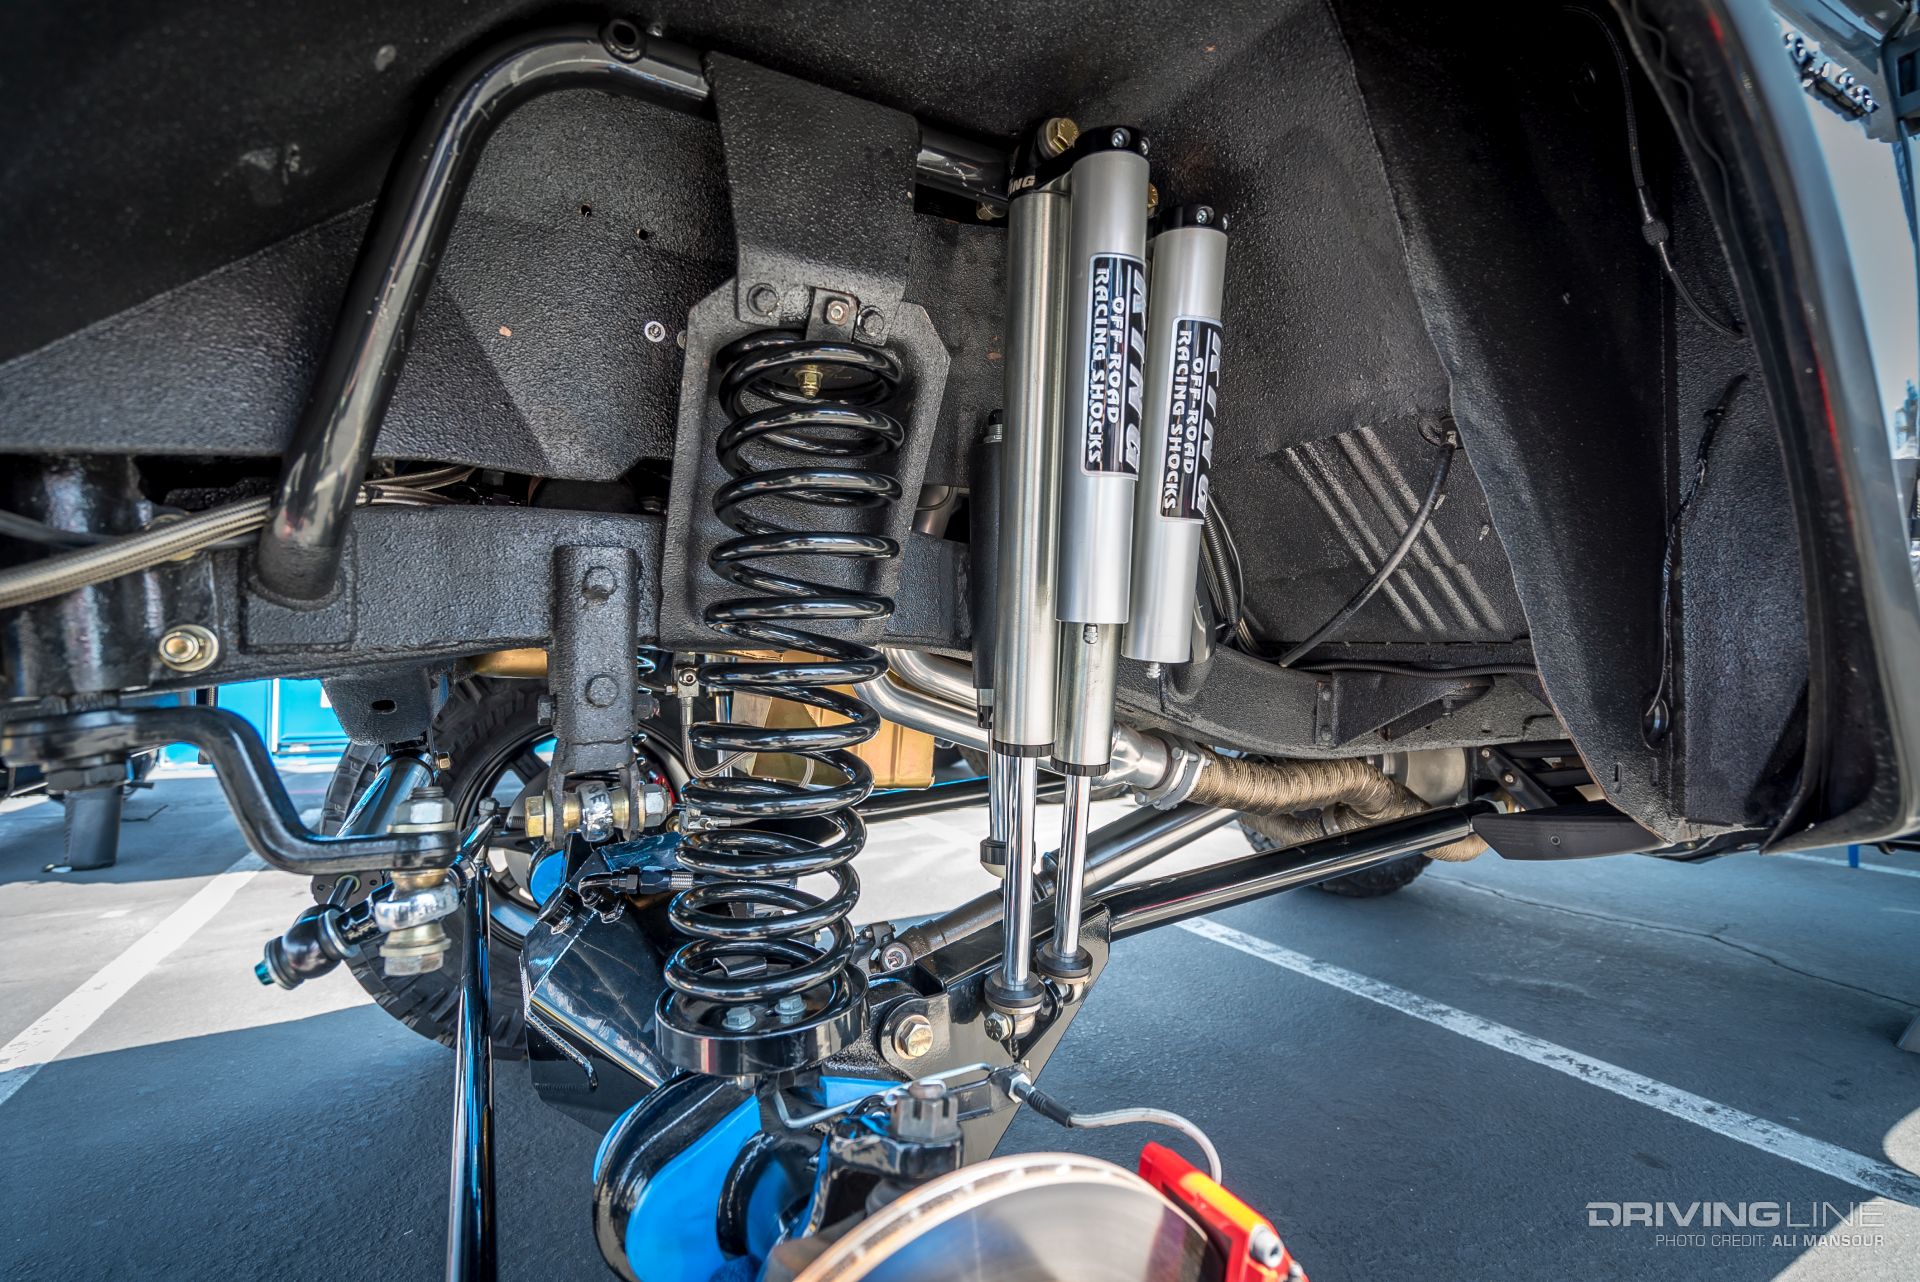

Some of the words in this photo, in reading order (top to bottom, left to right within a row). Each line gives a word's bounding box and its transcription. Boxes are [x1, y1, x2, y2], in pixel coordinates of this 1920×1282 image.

[1092, 267, 1110, 361] RACING
[1106, 296, 1125, 424] OFF-ROAD
[1087, 369, 1105, 463] SHOCKS
[1172, 330, 1192, 415] RACING
[1183, 357, 1204, 474] OFF-ROAD
[1164, 424, 1184, 509] SHOCKS
